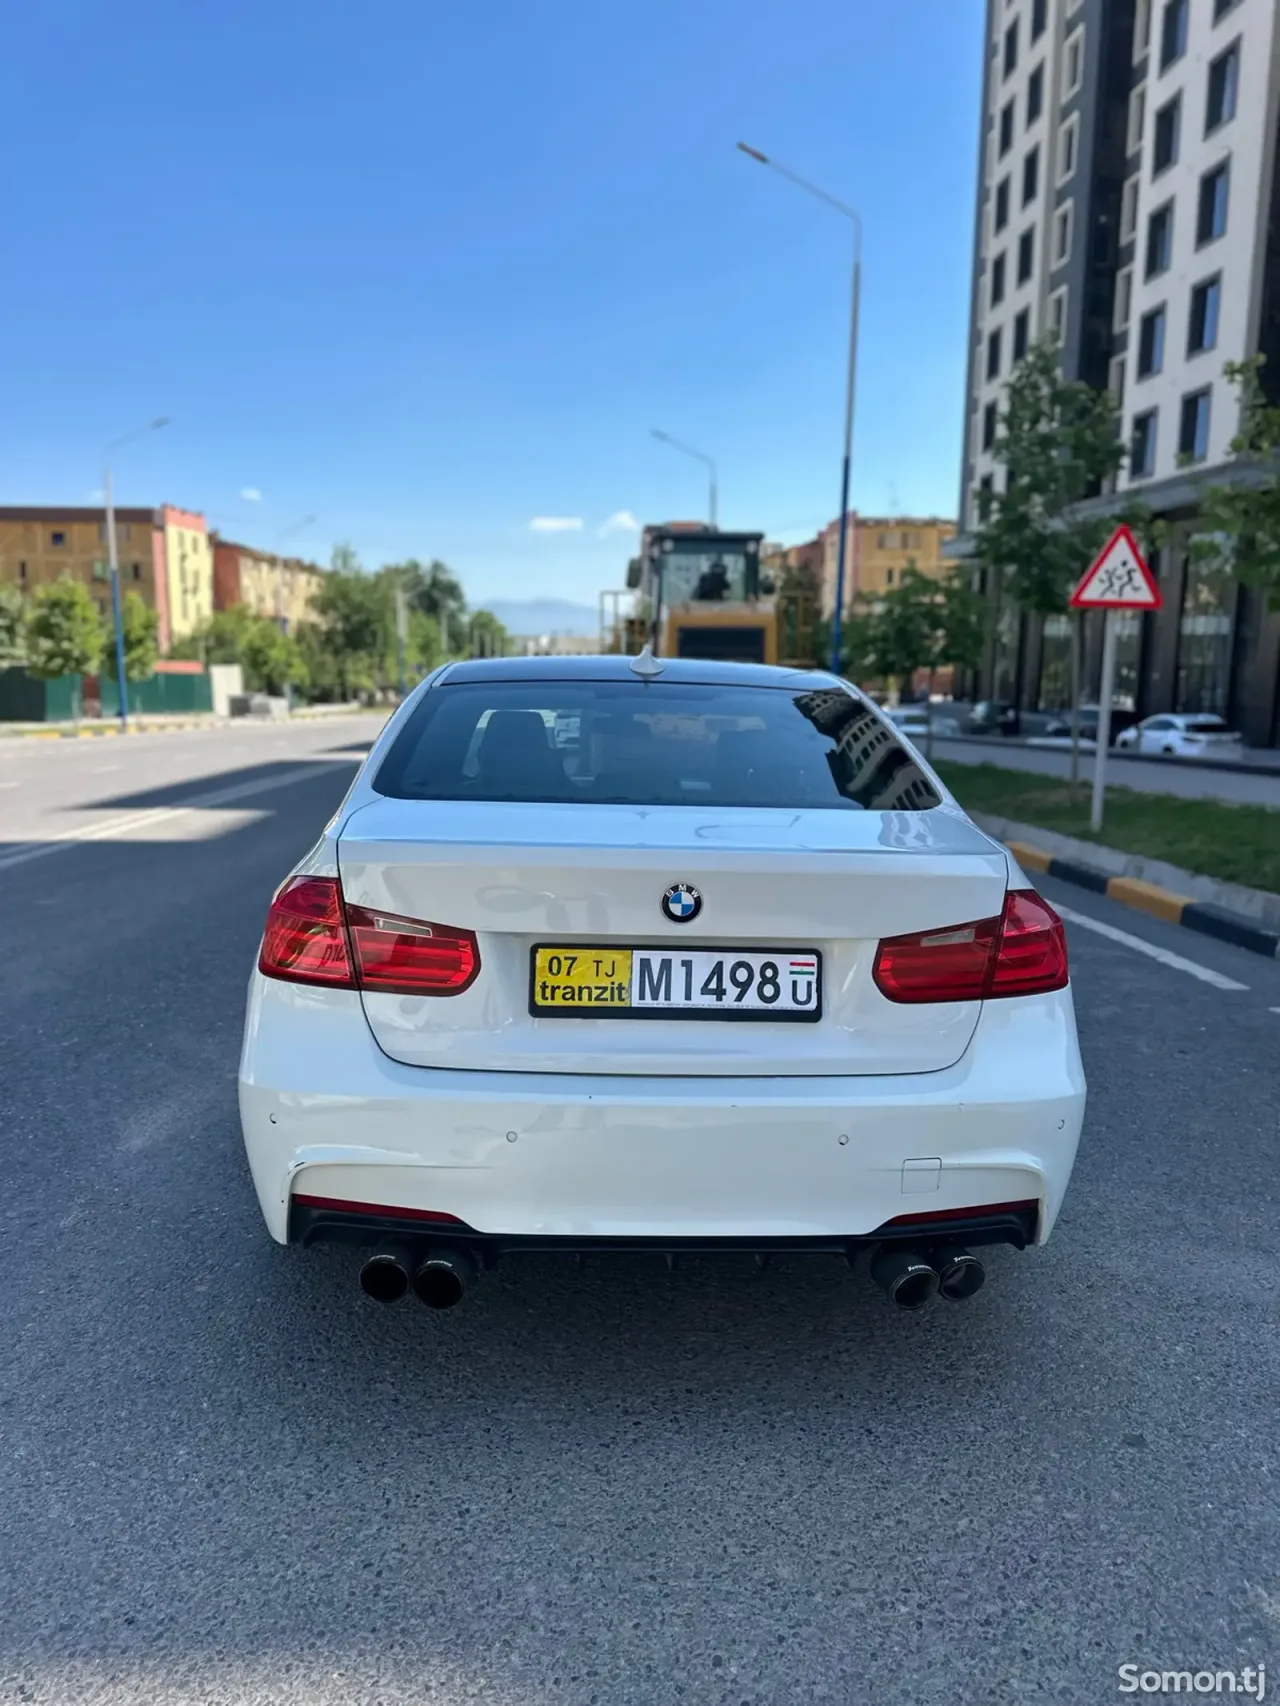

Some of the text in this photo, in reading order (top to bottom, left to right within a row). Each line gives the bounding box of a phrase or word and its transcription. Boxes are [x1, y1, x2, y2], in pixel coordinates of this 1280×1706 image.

[666, 884, 700, 899] BMW
[548, 955, 616, 978] 07 TJ
[539, 980, 626, 1002] tranzit
[638, 957, 813, 1006] M1498 U
